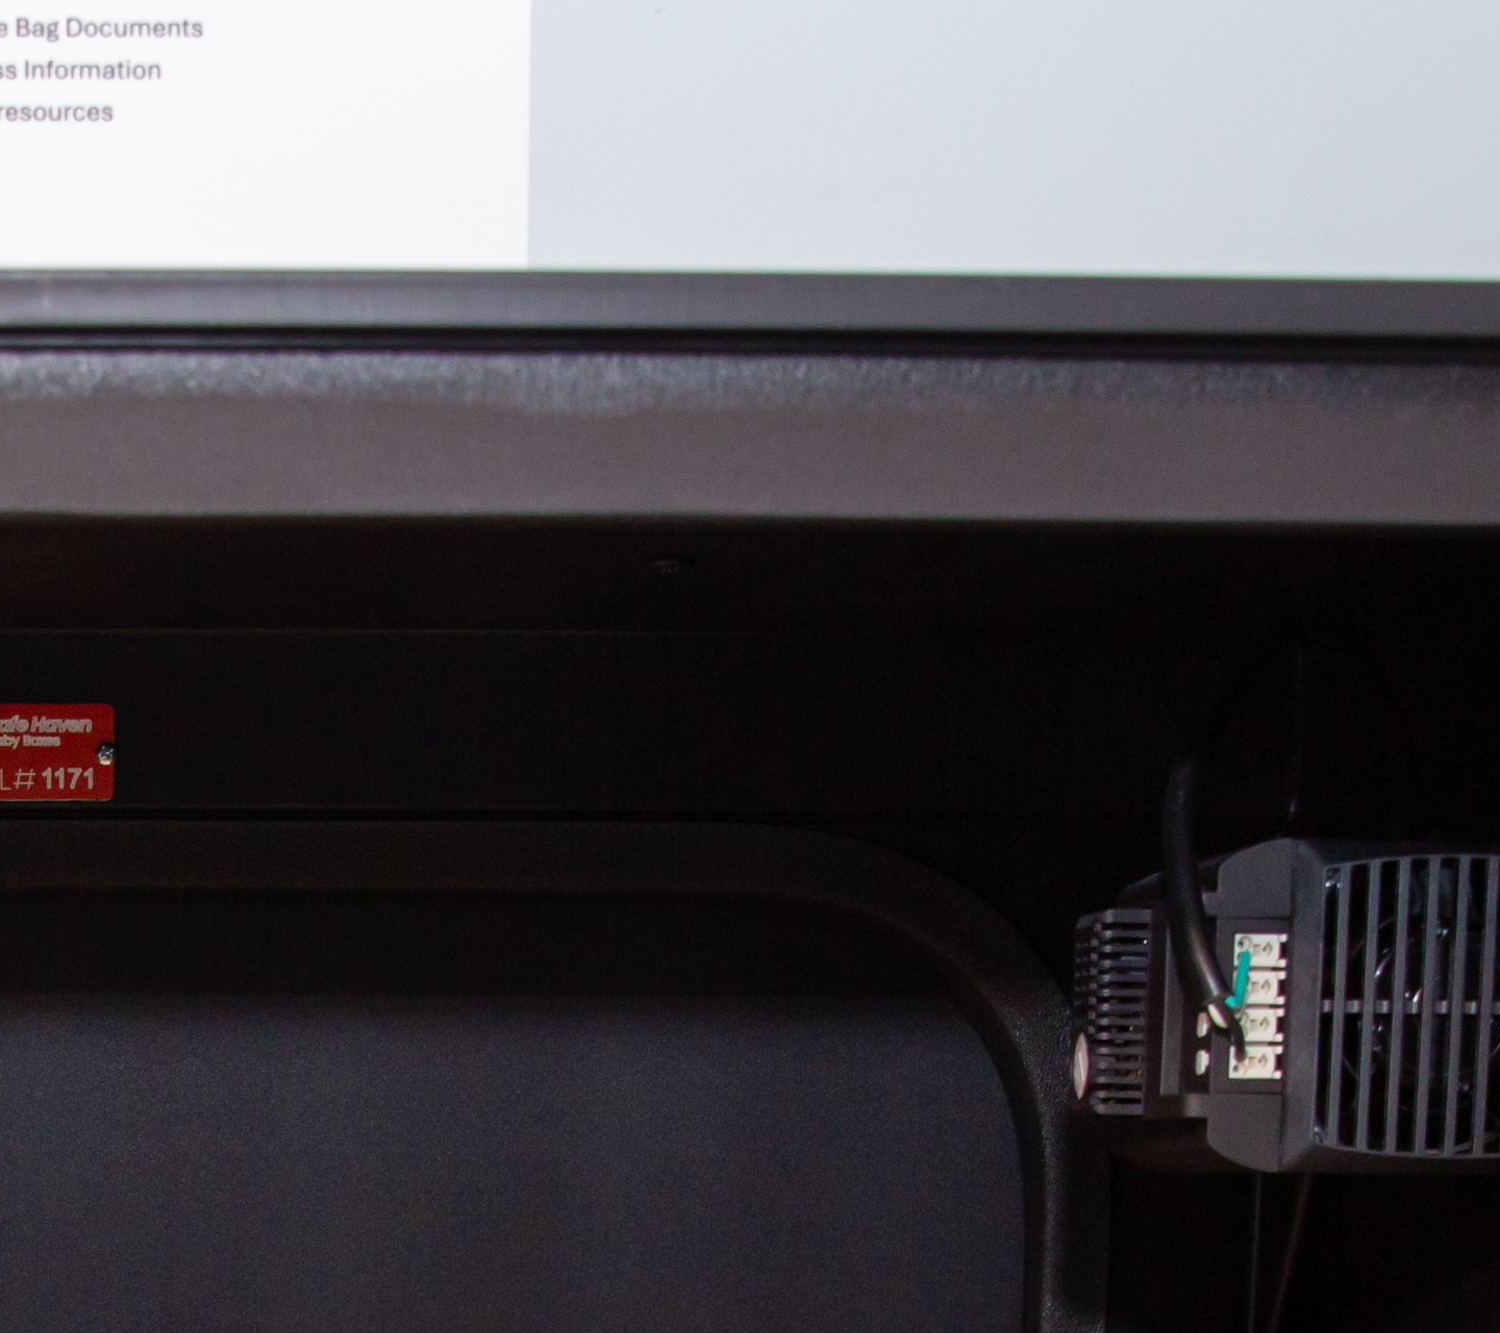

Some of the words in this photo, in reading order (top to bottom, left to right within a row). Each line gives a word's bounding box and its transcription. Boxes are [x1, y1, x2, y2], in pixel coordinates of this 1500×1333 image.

[15, 17, 60, 43] Bag
[65, 16, 204, 38] Documents
[24, 59, 162, 81] Information
[29, 715, 93, 734] Haven
[12, 767, 37, 791] #
[41, 766, 94, 790] 1171
